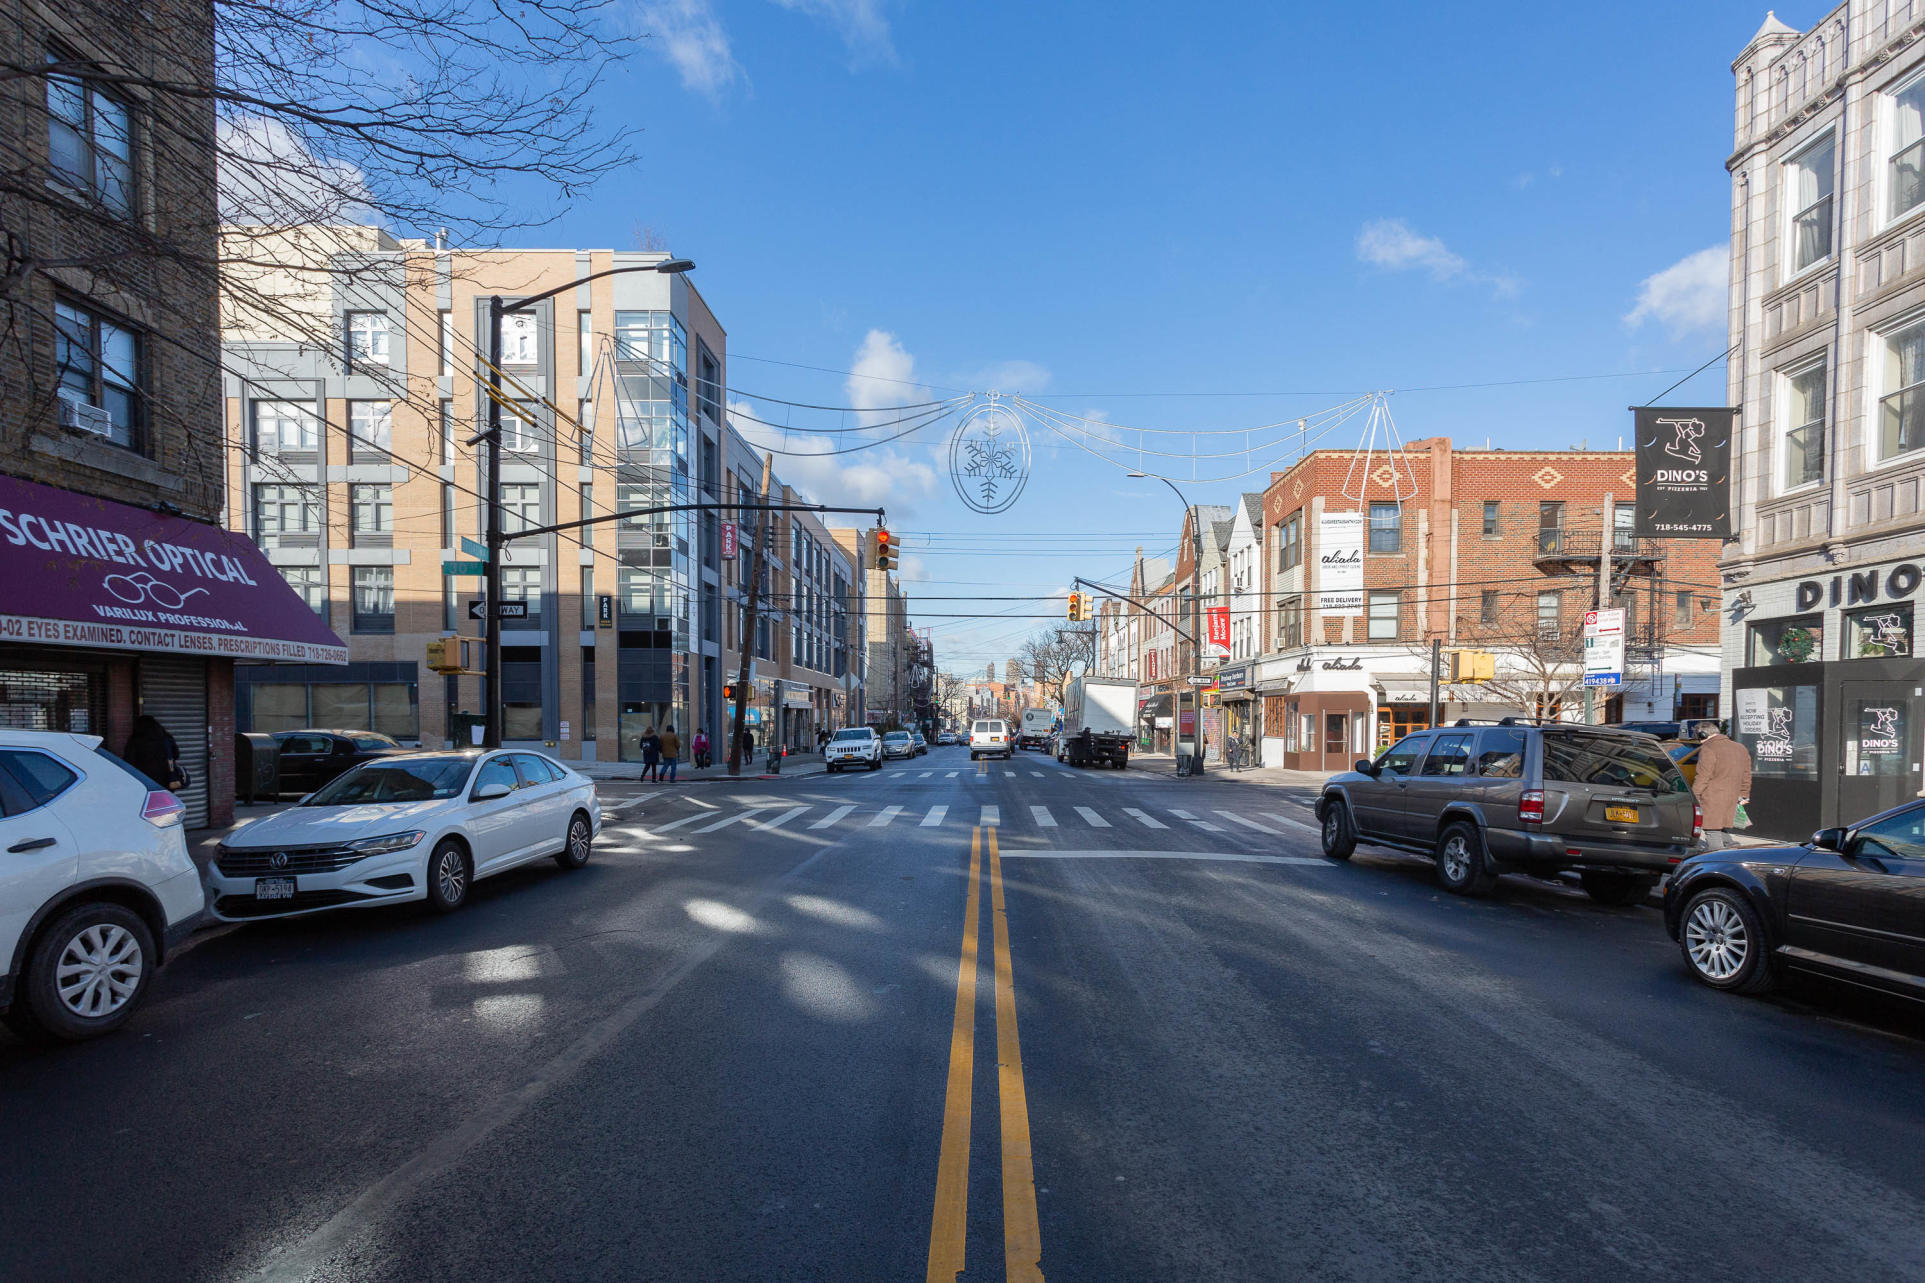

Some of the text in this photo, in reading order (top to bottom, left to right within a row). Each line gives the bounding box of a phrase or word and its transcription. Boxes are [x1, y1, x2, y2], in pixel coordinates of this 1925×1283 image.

[1656, 469, 1708, 482] DINO'S
[725, 525, 733, 551] PARK
[1655, 523, 1712, 531] 718-545-4775
[0, 508, 258, 586] SCHRIER OPTICAL
[1796, 563, 1925, 612] DINO
[92, 604, 248, 632] VARILUX PROFESSIONAL
[501, 604, 520, 615] WAY
[0, 618, 23, 637] -02
[27, 620, 60, 640] EYES
[129, 630, 176, 649] CONTACT
[218, 638, 280, 656] PRESCRIPTIONS
[282, 644, 306, 658] FILLED
[1212, 609, 1220, 640] Benjamin
[1862, 739, 1898, 748] DINO'S
